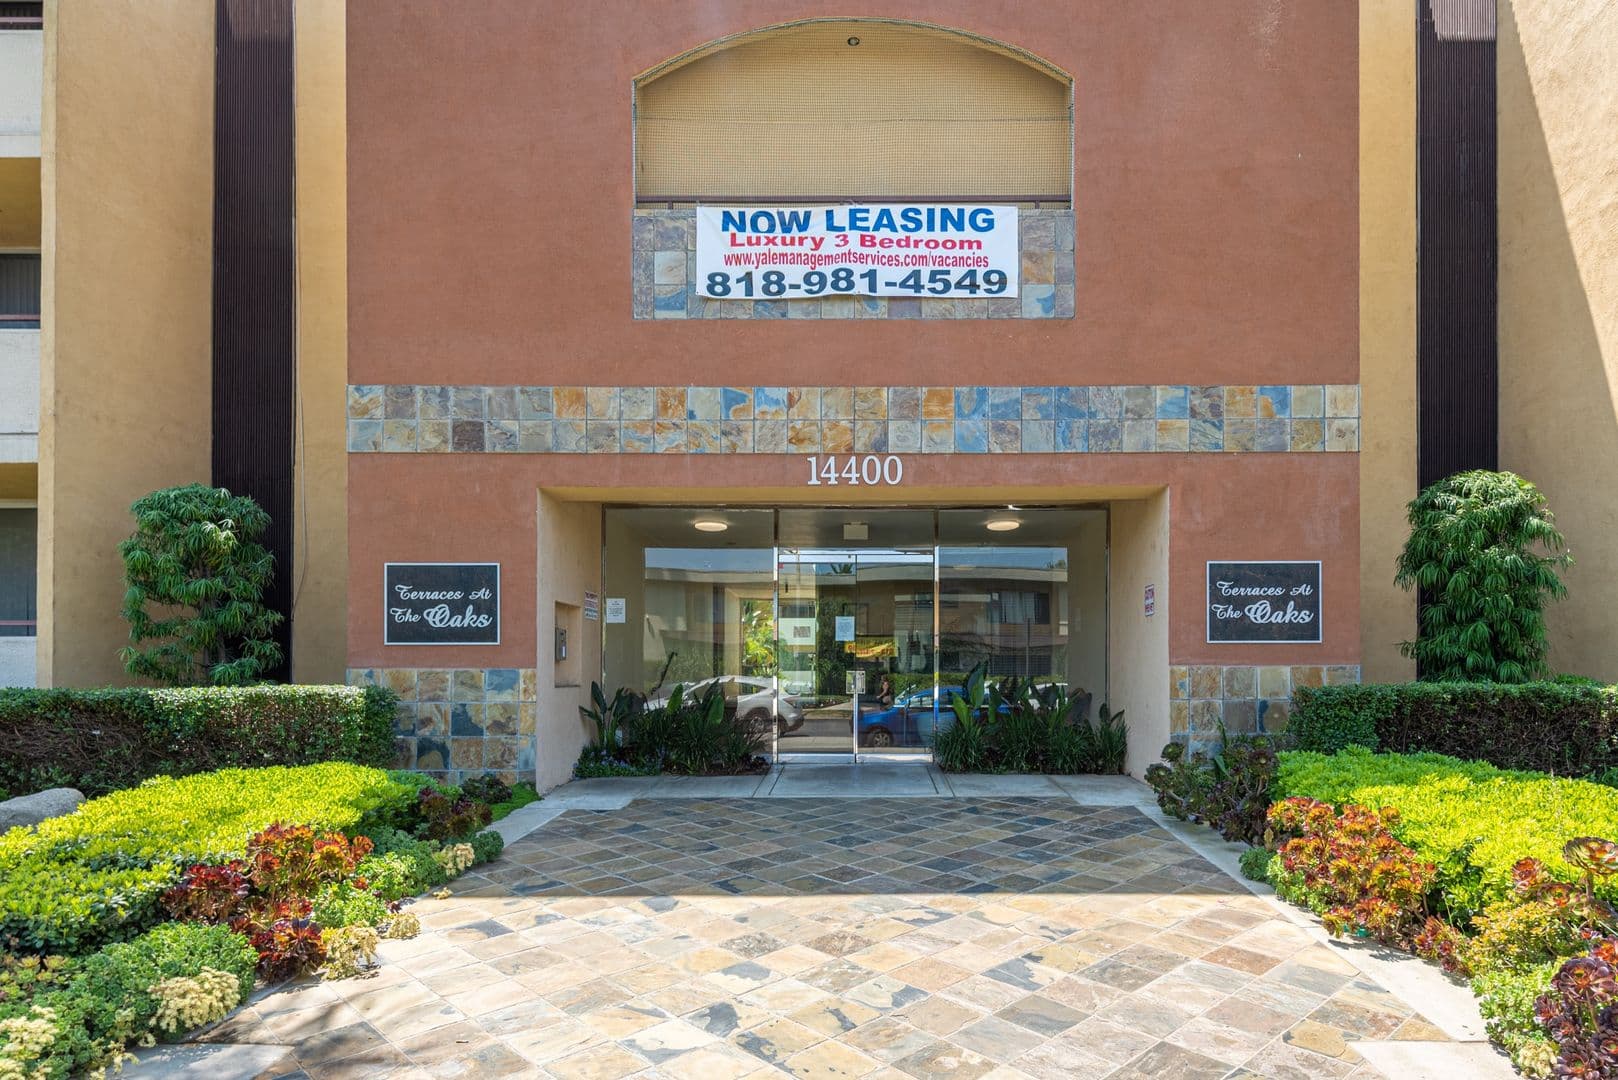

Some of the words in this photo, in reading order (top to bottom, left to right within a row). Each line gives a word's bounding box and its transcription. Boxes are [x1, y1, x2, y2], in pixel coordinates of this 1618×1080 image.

[721, 210, 812, 234] NOW
[825, 208, 995, 233] LEASING
[730, 233, 825, 250] Luxury
[835, 234, 849, 248] 3
[859, 234, 983, 250] Bedroom
[724, 249, 989, 270] www.yalemanagementservices.com/vacancies
[706, 268, 1008, 297] 818-981-4549
[807, 455, 903, 485] 14400
[395, 584, 464, 600] Terraces
[469, 588, 492, 600] At
[1216, 581, 1285, 596] Terraces
[1290, 584, 1313, 596] At
[390, 607, 422, 623] The
[423, 604, 493, 628] Oaks
[1211, 604, 1243, 619] The
[1244, 600, 1314, 624] Oaks
